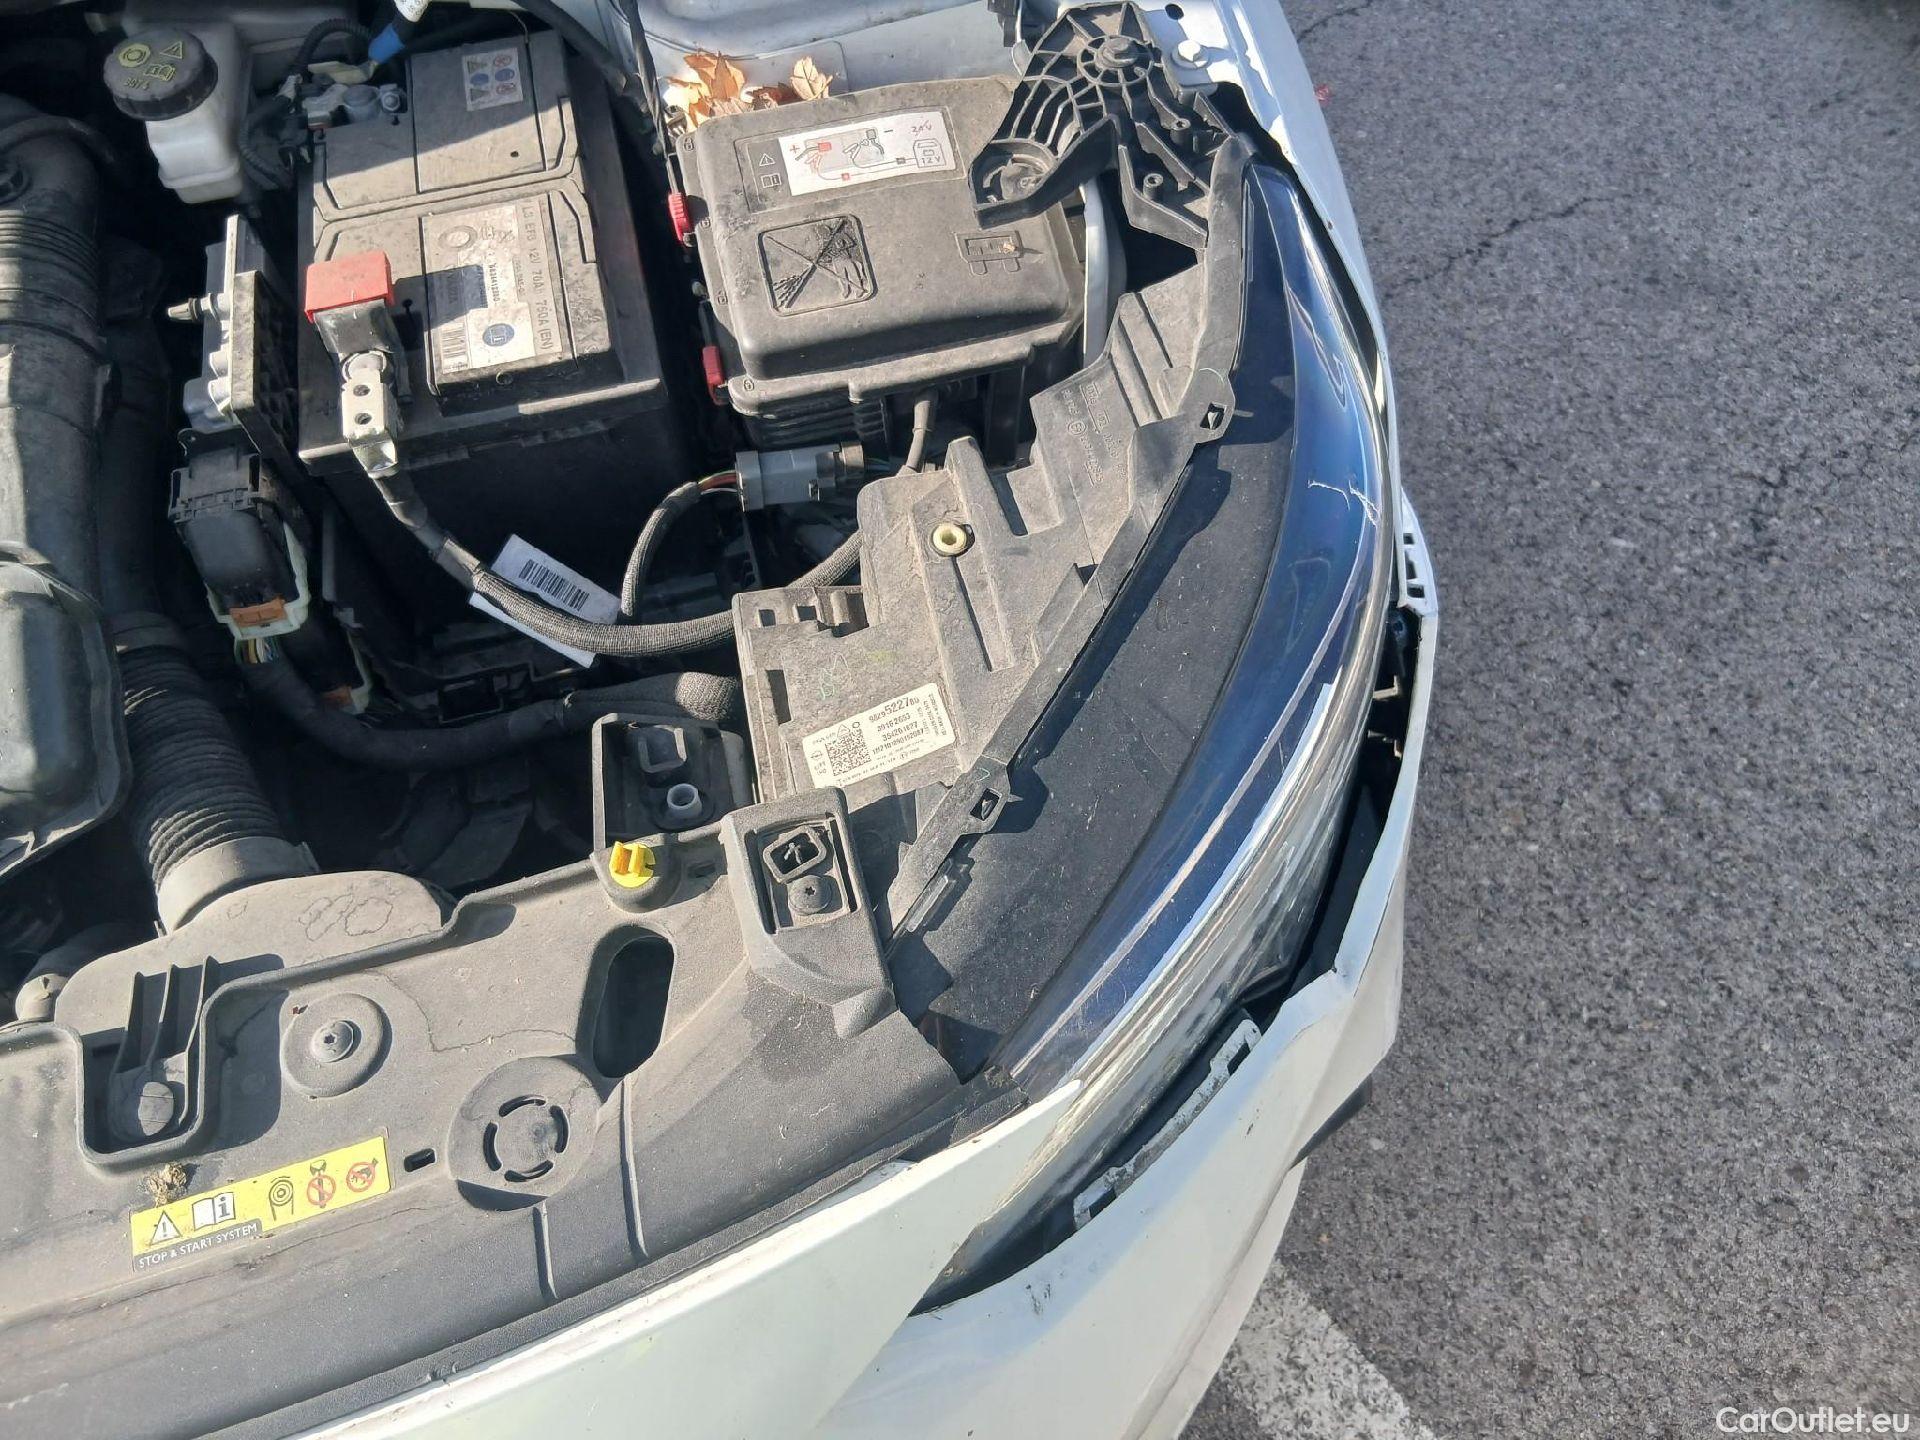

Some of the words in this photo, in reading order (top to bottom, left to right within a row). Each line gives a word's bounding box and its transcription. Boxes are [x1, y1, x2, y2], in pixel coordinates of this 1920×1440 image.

[139, 1252, 168, 1269] STOP
[170, 1249, 178, 1257] &
[180, 1237, 214, 1255] START
[217, 1223, 258, 1244] SYSTEM
